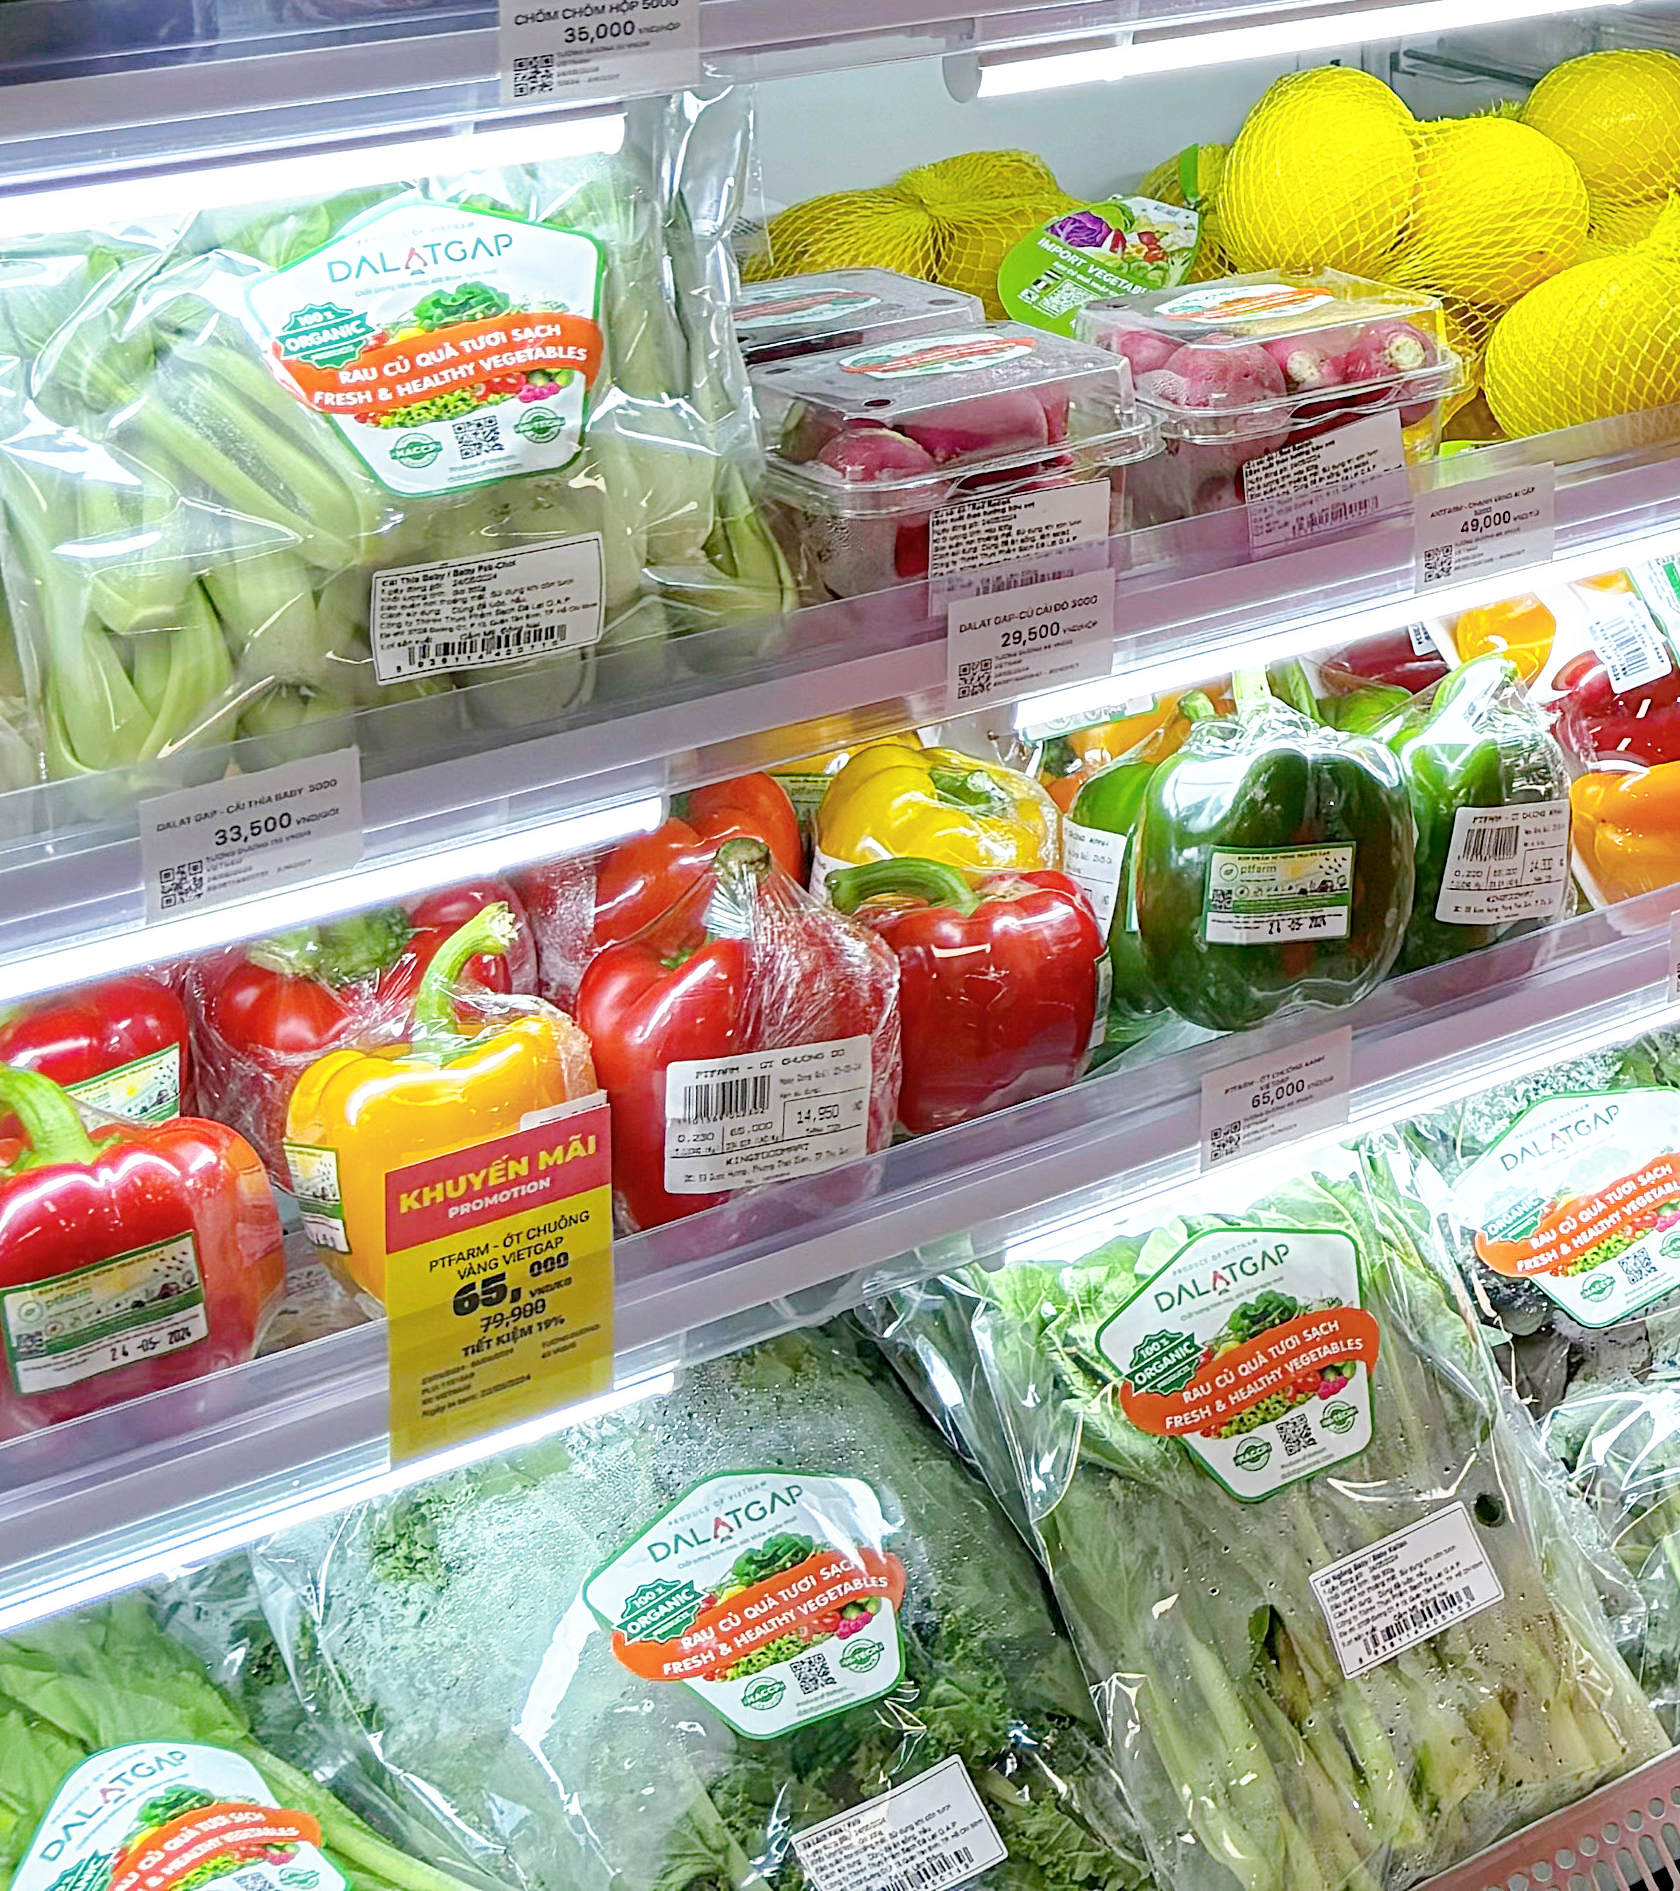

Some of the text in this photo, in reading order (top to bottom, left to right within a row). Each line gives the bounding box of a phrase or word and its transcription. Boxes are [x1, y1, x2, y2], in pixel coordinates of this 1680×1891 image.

[514, 8, 559, 25] CHÔM
[562, 3, 606, 20] CHÔM
[564, 20, 636, 44] 35,000
[327, 232, 514, 284] DALATGAP
[1036, 236, 1087, 268] IMPORT
[284, 319, 368, 352] ORGANIC
[338, 323, 562, 385] RAU CỦ QUẢ TƯƠI SẠCH
[314, 345, 588, 408] FRESH & HEALTHY VEGETABLES
[1460, 510, 1511, 533] 49,000
[1001, 621, 1061, 648] 29,500
[214, 811, 292, 846] 33,500
[1251, 1079, 1305, 1109] 65,000
[1501, 1104, 1620, 1171] DALATGAP
[399, 1133, 597, 1213] KHUYẾN MÃI
[448, 1177, 551, 1219] PROMOTION
[1486, 1193, 1541, 1236] ORGANIC
[1528, 1163, 1673, 1250] RAU CỦ QUẢ TƯƠI SẠCH
[429, 1243, 490, 1272] PTFARM
[457, 1237, 564, 1280] VÀNG VIETGAP
[1516, 1211, 1622, 1272] FRESH & HEALTHY
[452, 1251, 570, 1317] 65, 000
[1153, 1243, 1289, 1313] DALATGAP
[461, 1324, 533, 1357] TIẾT KIỆM
[1134, 1341, 1196, 1385] ORGANIC
[1182, 1320, 1339, 1405] RAU CỦ QUẢ TƯƠI SẠCH
[1165, 1337, 1364, 1429] FRESH & HEALTHY VEGETABLES
[647, 1484, 804, 1563] DALATGAP
[627, 1586, 695, 1634] ORGANIC
[662, 1575, 888, 1675] FRESH & HEALTHY VEGETABLES
[681, 1574, 817, 1651] RAU CỦ QUẢ TƯƠI
[39, 1749, 188, 1863] DALATGAP
